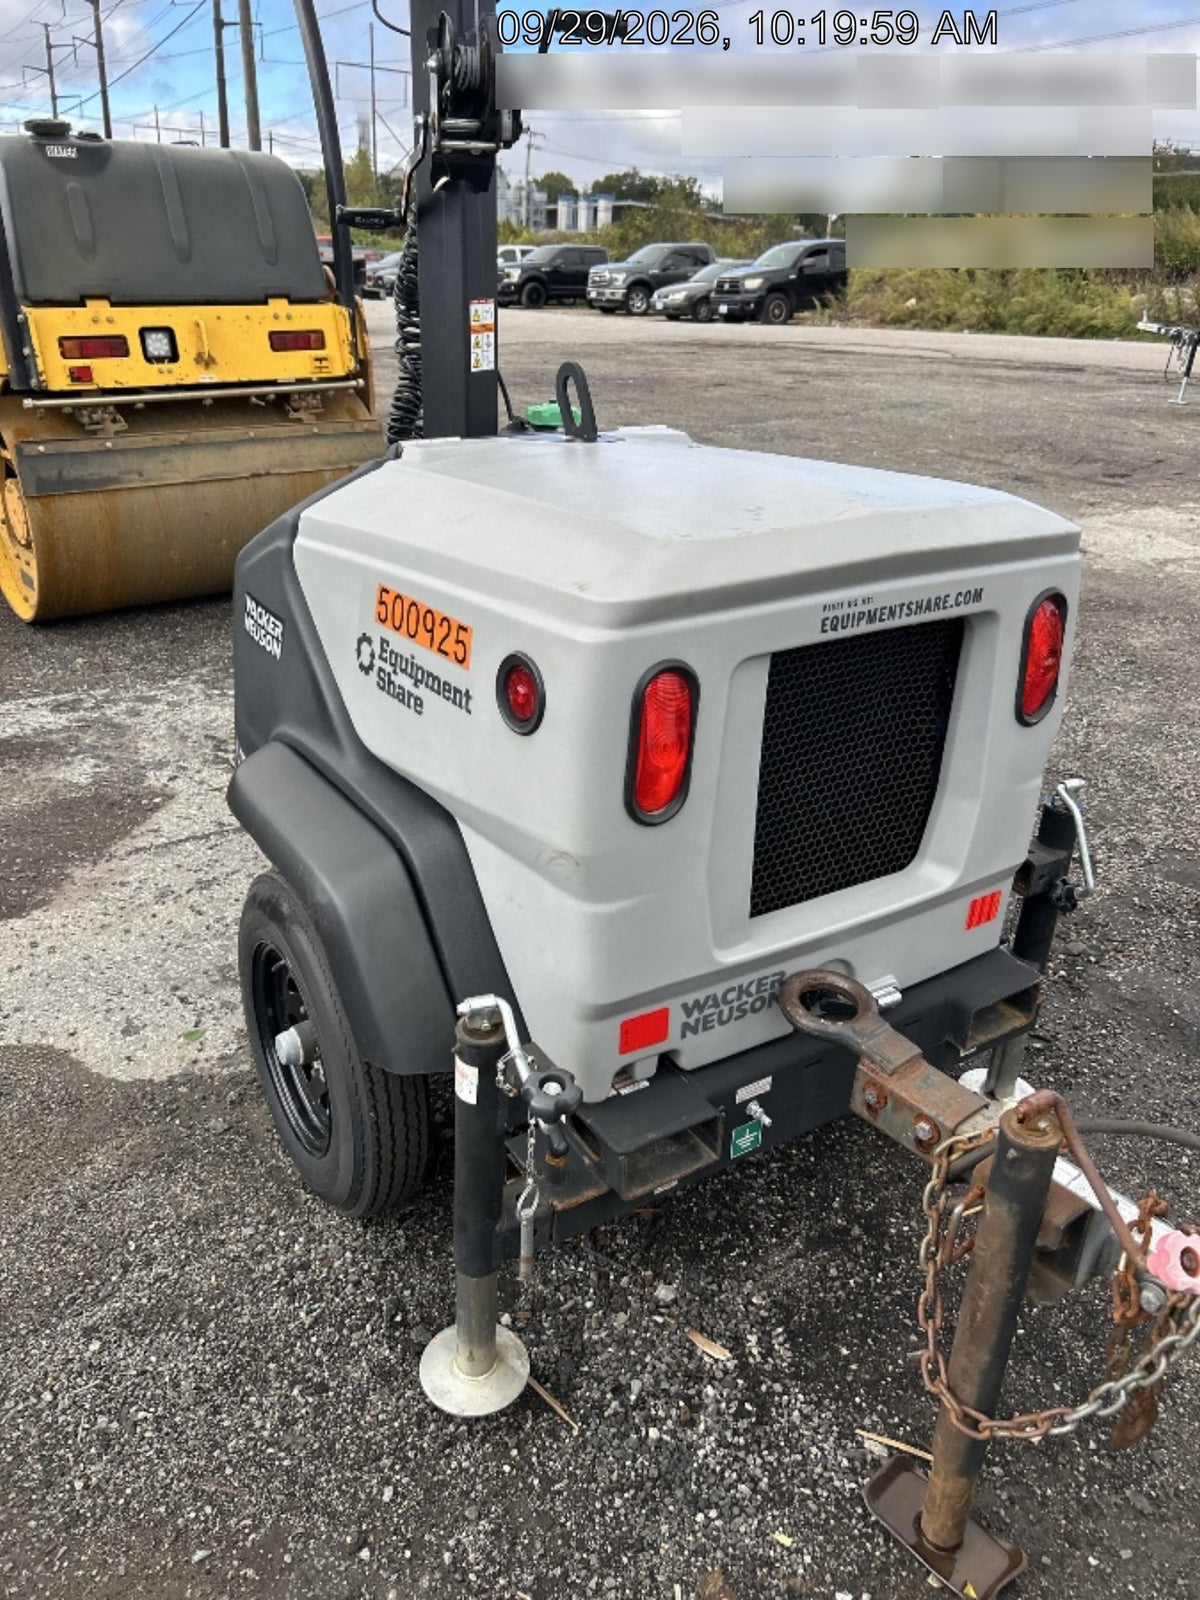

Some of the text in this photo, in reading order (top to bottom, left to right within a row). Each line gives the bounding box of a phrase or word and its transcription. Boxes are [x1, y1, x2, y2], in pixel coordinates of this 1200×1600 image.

[245, 593, 283, 641] WACKER
[377, 587, 467, 664] 500925
[820, 588, 984, 633] EQUIPMENTSHARE.COM
[245, 612, 281, 660] NEUSON
[377, 666, 424, 715] Share
[378, 637, 472, 715] Equipment
[680, 970, 786, 1019] WACKER
